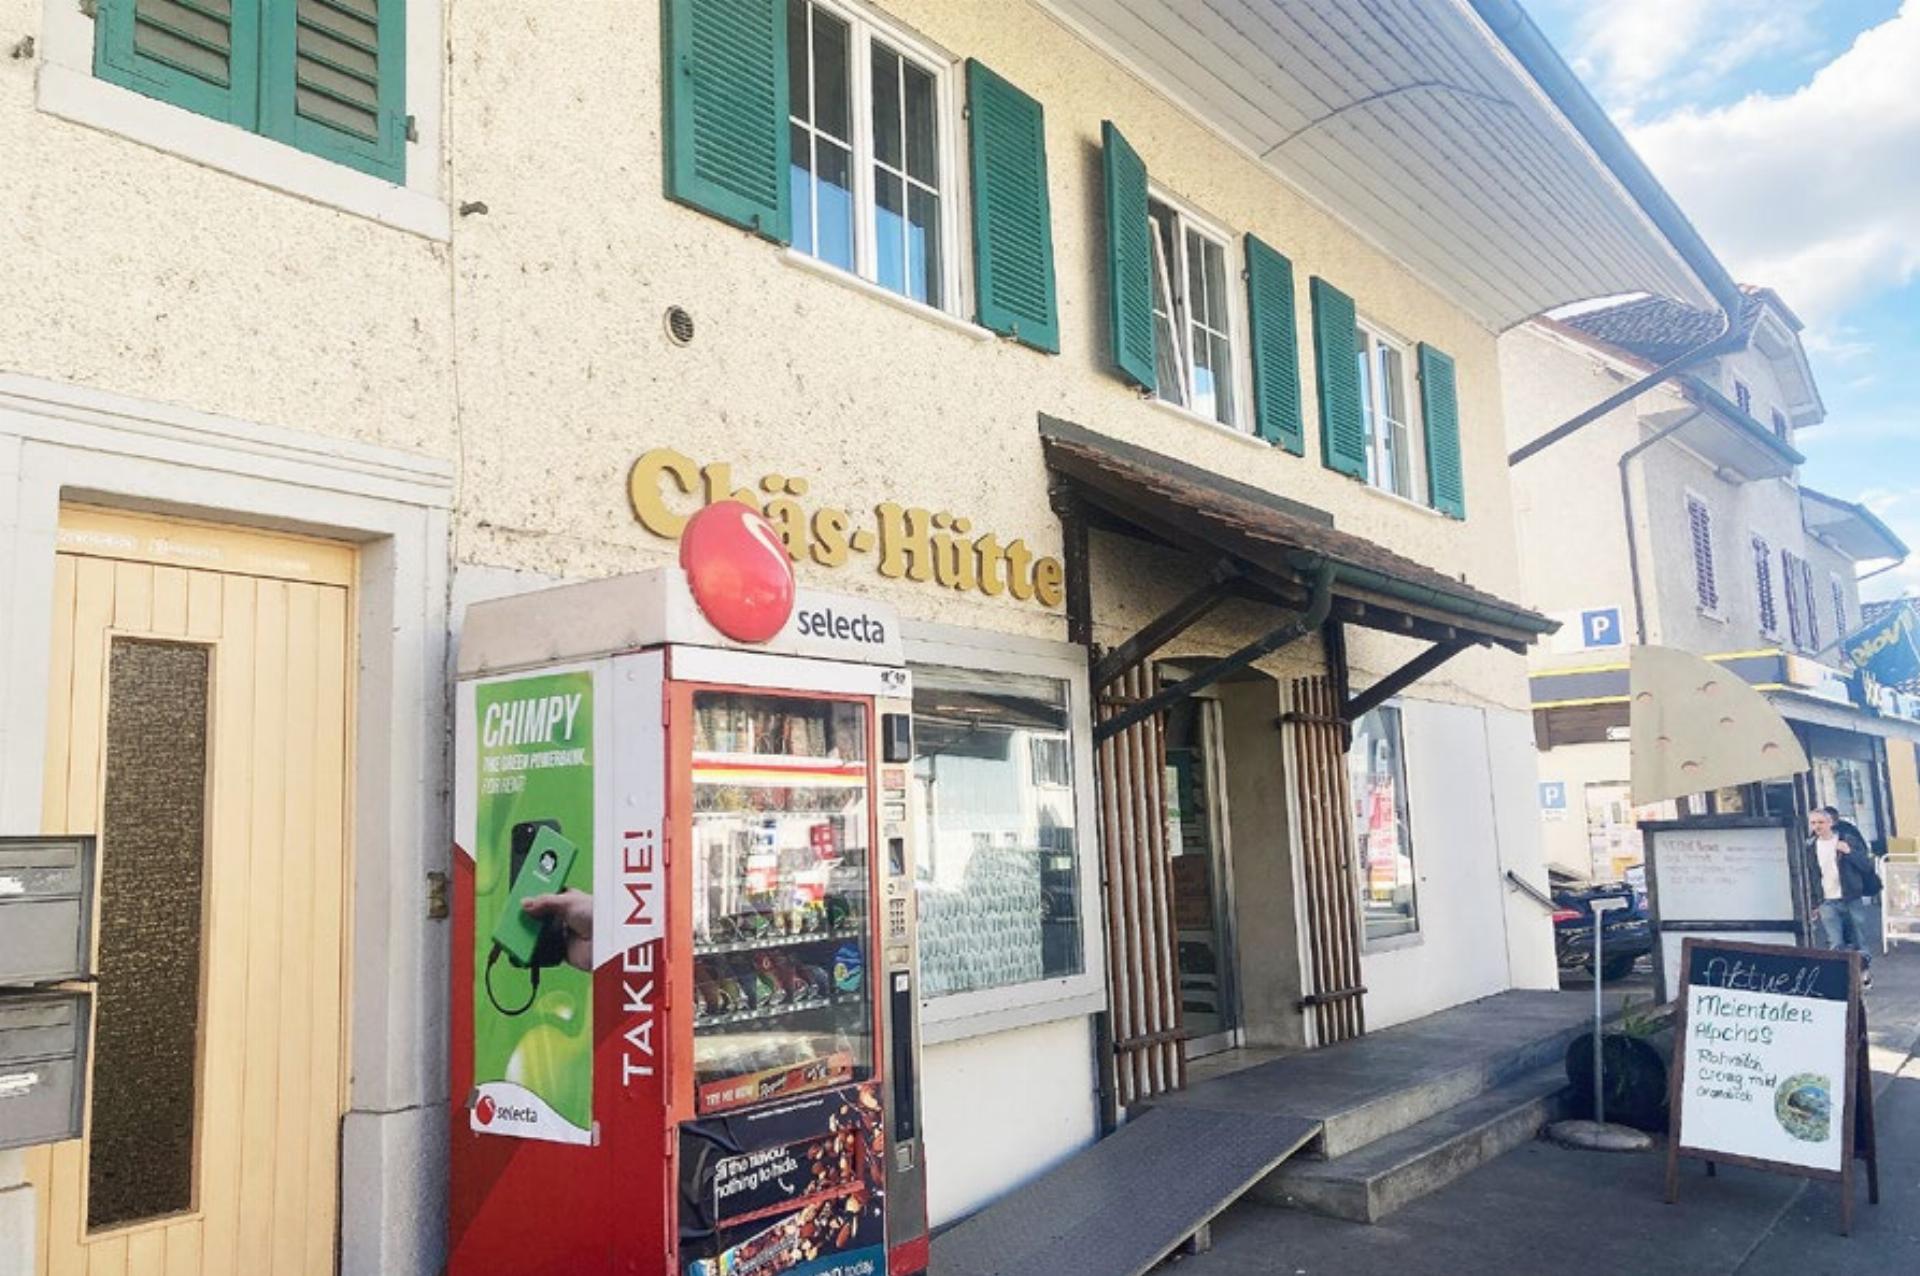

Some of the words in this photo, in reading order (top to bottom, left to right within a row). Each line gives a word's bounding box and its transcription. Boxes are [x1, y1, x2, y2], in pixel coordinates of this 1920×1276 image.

[798, 609, 885, 645] selecta
[1591, 616, 1610, 641] P
[482, 693, 582, 748] CHIMPY
[624, 829, 654, 925] ME!
[1703, 957, 1823, 996] Aktuell
[623, 943, 654, 1086] TAKE
[497, 1104, 539, 1124] selecta
